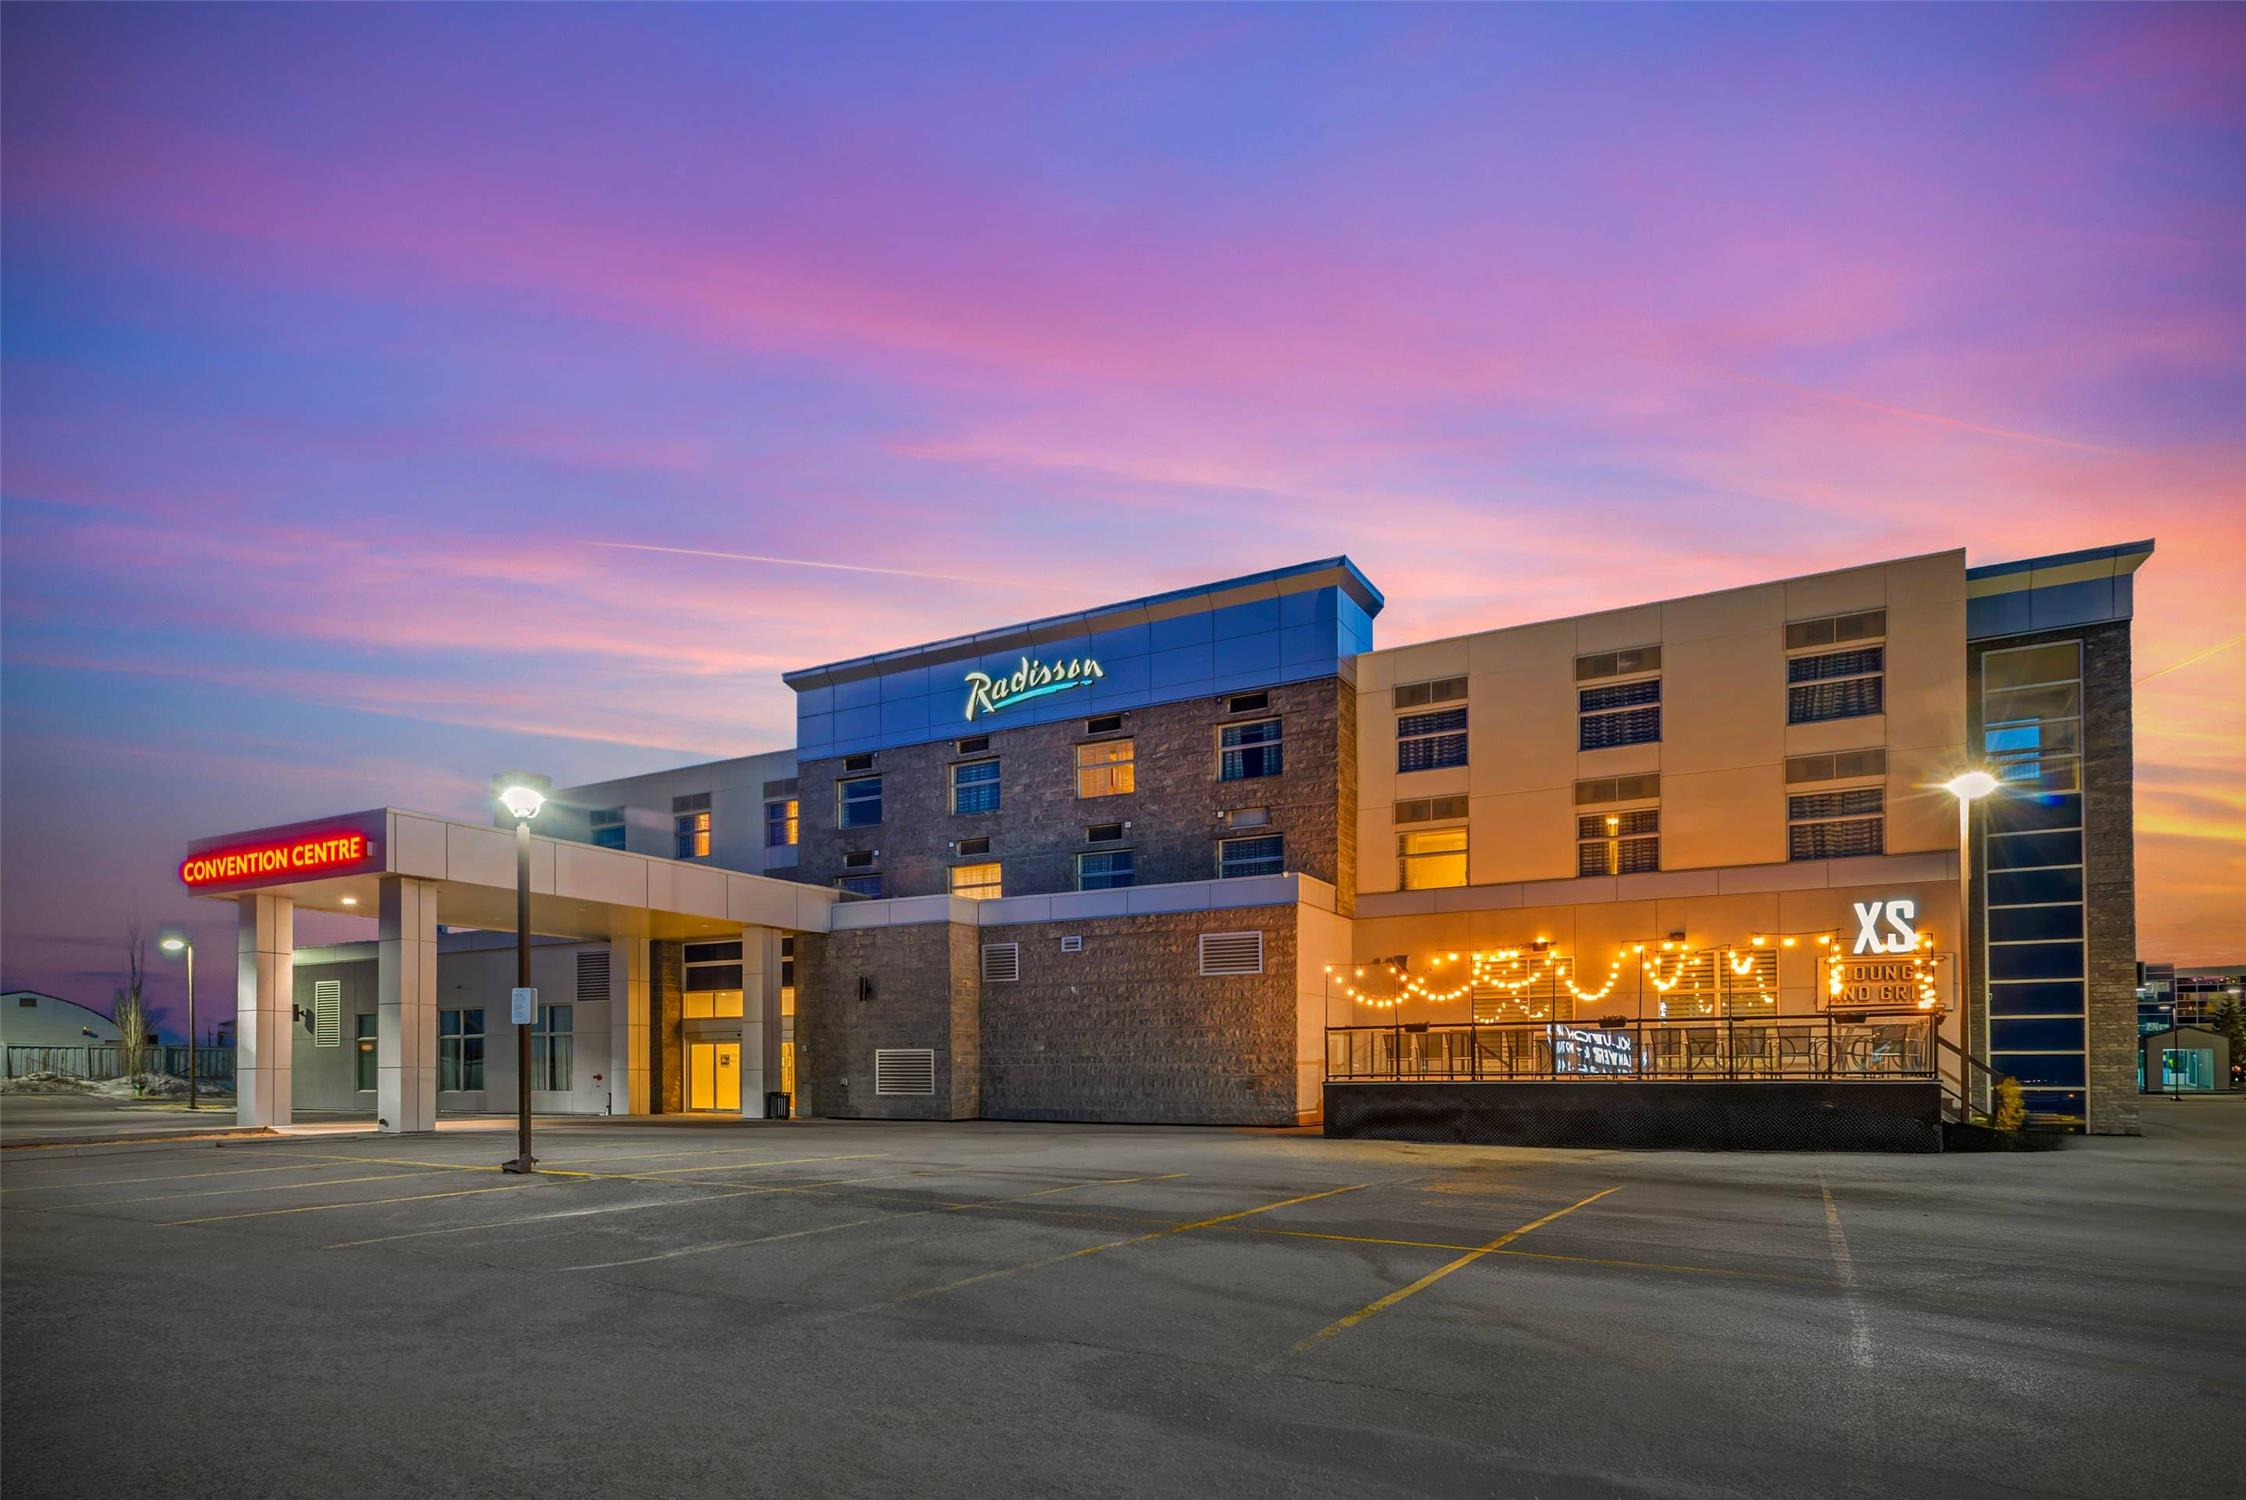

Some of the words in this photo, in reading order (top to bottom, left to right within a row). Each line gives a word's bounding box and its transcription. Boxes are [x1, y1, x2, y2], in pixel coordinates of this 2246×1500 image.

[964, 656, 1105, 722] Radisson
[183, 847, 288, 883] CONVENTION
[291, 836, 361, 867] CENTRE
[1852, 899, 1916, 955] XS
[1879, 984, 1934, 1001] GRI
